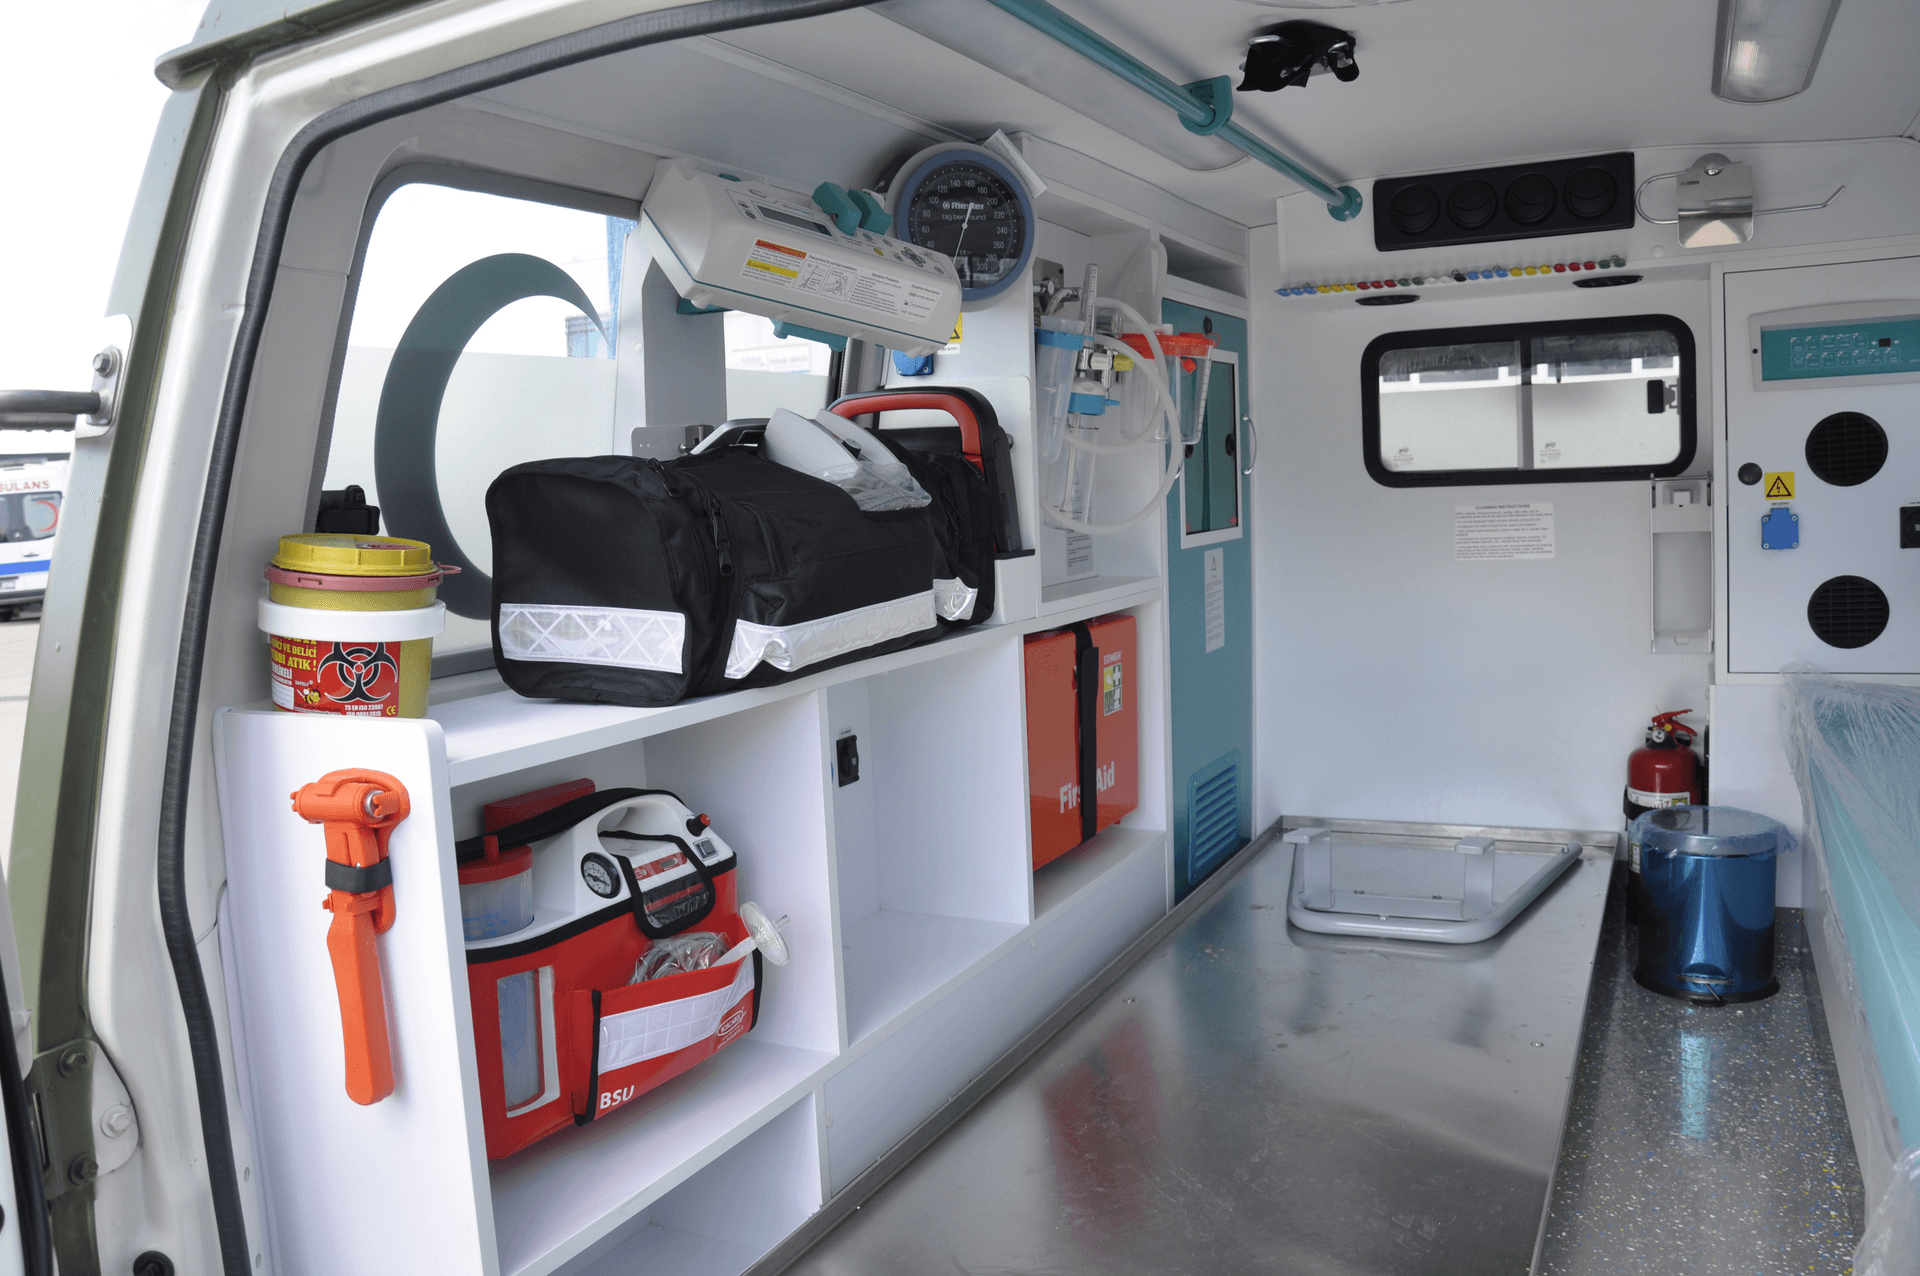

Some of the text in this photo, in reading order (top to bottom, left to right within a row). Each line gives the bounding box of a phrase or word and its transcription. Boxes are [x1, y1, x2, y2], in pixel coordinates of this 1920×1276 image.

[950, 180, 960, 188] 140
[965, 180, 975, 188] 160
[937, 185, 948, 193] 120
[928, 196, 939, 204] 100
[987, 197, 998, 205] 200
[994, 211, 1005, 219] 220
[993, 241, 1005, 249] 260
[977, 263, 988, 271] 300
[1096, 761, 1115, 794] Aid
[600, 1085, 635, 1110] BSU
